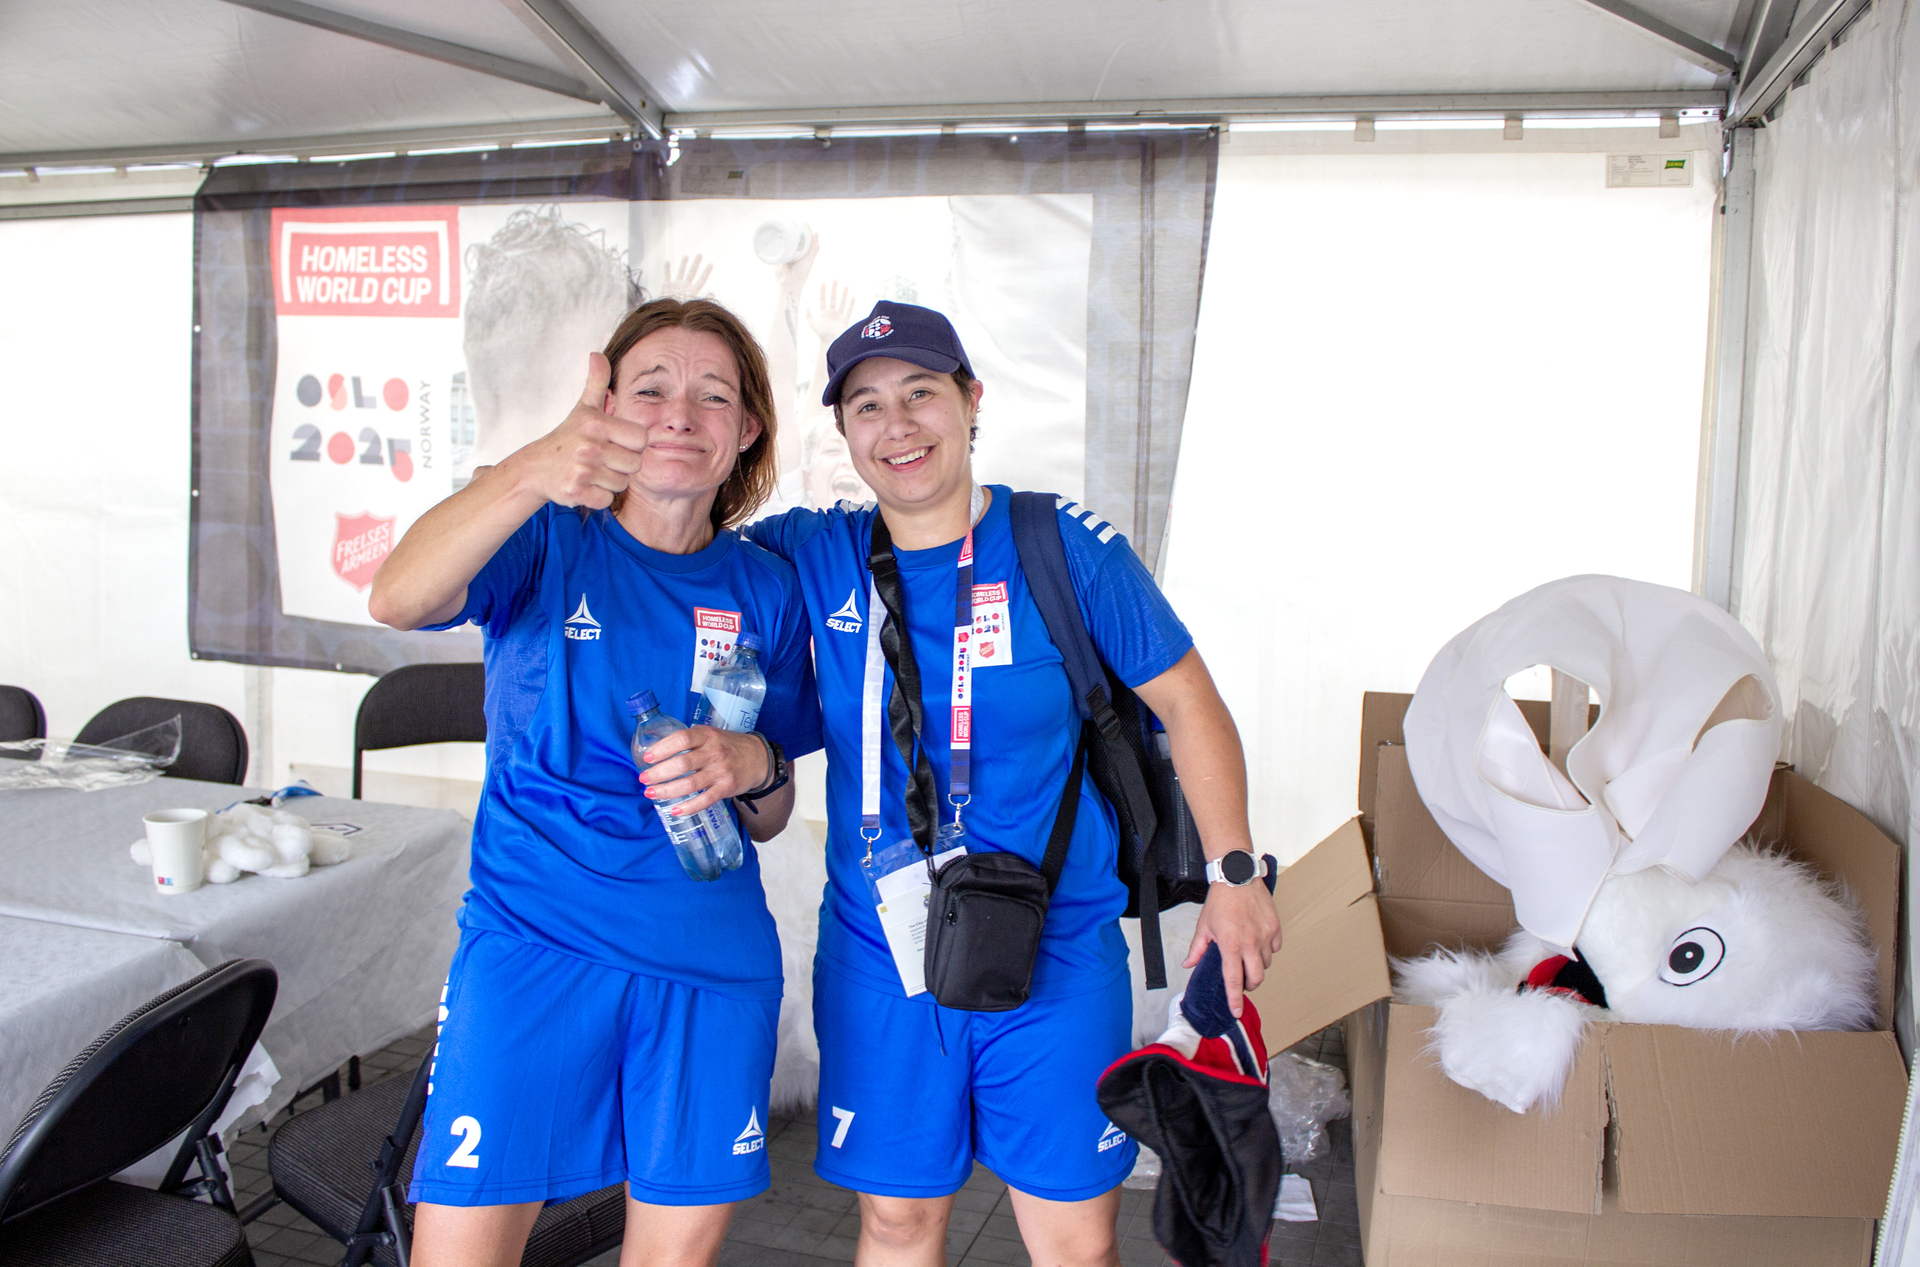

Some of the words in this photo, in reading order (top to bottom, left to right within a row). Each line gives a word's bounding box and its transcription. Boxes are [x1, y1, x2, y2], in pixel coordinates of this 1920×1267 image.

[301, 245, 428, 273] HOMELESS
[296, 275, 379, 304] WORLD
[381, 277, 432, 305] CUP
[296, 372, 410, 412] OSLO
[419, 380, 432, 469] NORWAY
[289, 423, 414, 483] 2025
[336, 522, 390, 562] FRELSES
[340, 540, 390, 575] ARMEEN
[972, 589, 1001, 597] OMELESS
[702, 615, 733, 625] HOMELESS
[702, 620, 723, 629] WORLD
[723, 623, 735, 631] CUP
[825, 618, 863, 634] SELECT
[701, 638, 731, 651] OSLO
[706, 808, 720, 830] PAN
[831, 1105, 856, 1149] 7
[447, 1115, 482, 1168] 2
[732, 1137, 764, 1155] SELECT
[1097, 1131, 1127, 1153] SELECT
